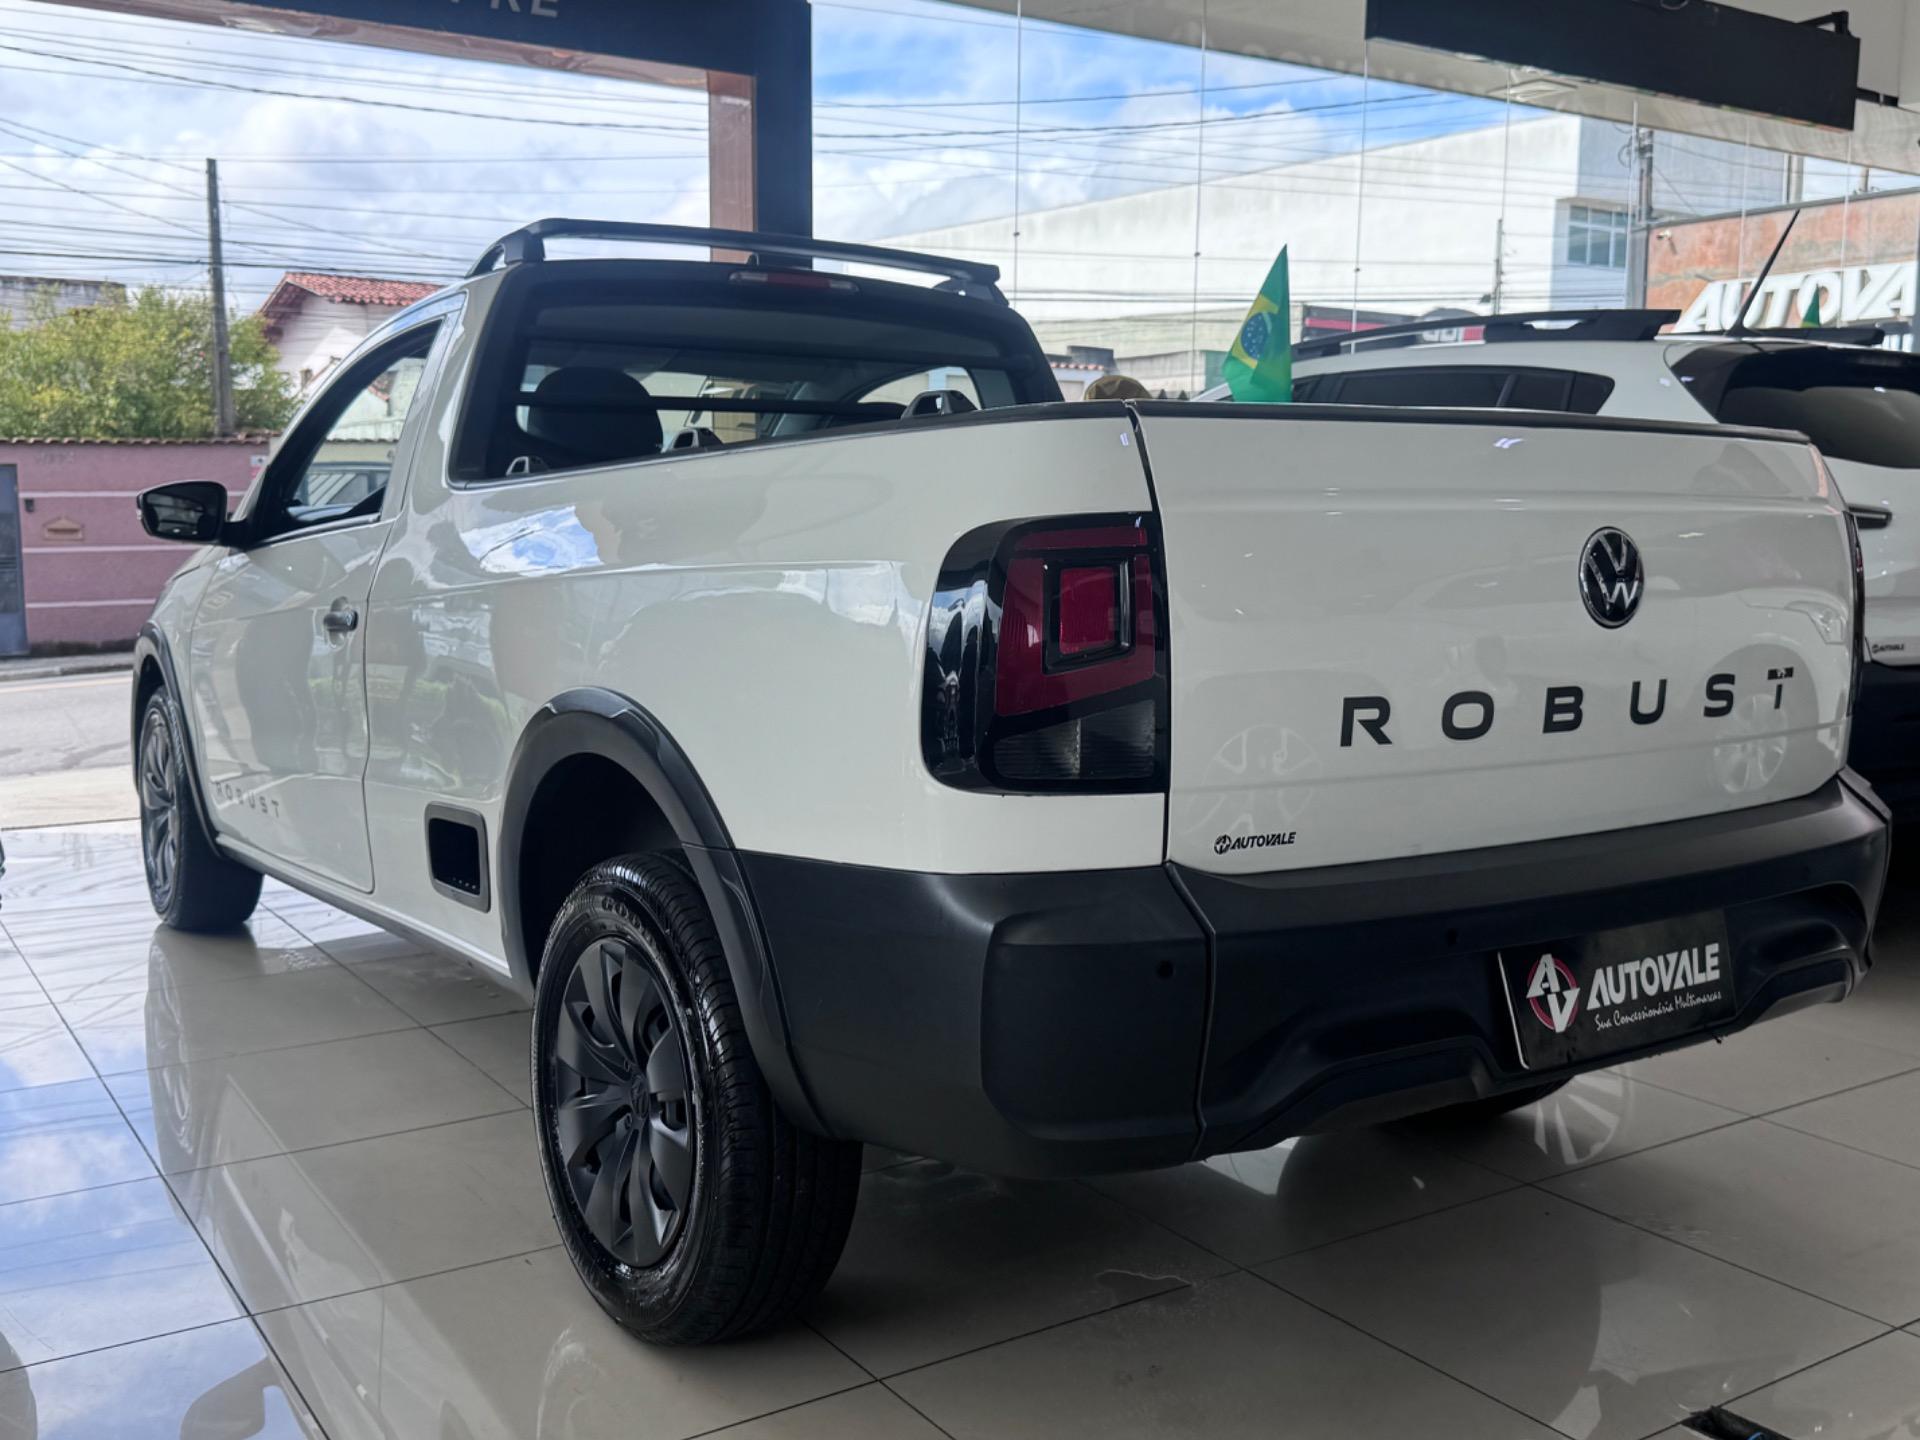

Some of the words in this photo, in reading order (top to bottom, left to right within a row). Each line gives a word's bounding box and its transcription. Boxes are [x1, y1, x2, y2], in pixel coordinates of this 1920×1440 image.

[1340, 666, 1794, 747] ROBUST
[1230, 831, 1297, 850] AUTOVALE
[1586, 942, 1721, 1011] AUTOVALE
[1594, 1013, 1613, 1032] Sua
[1674, 990, 1722, 1010] Multimarcas
